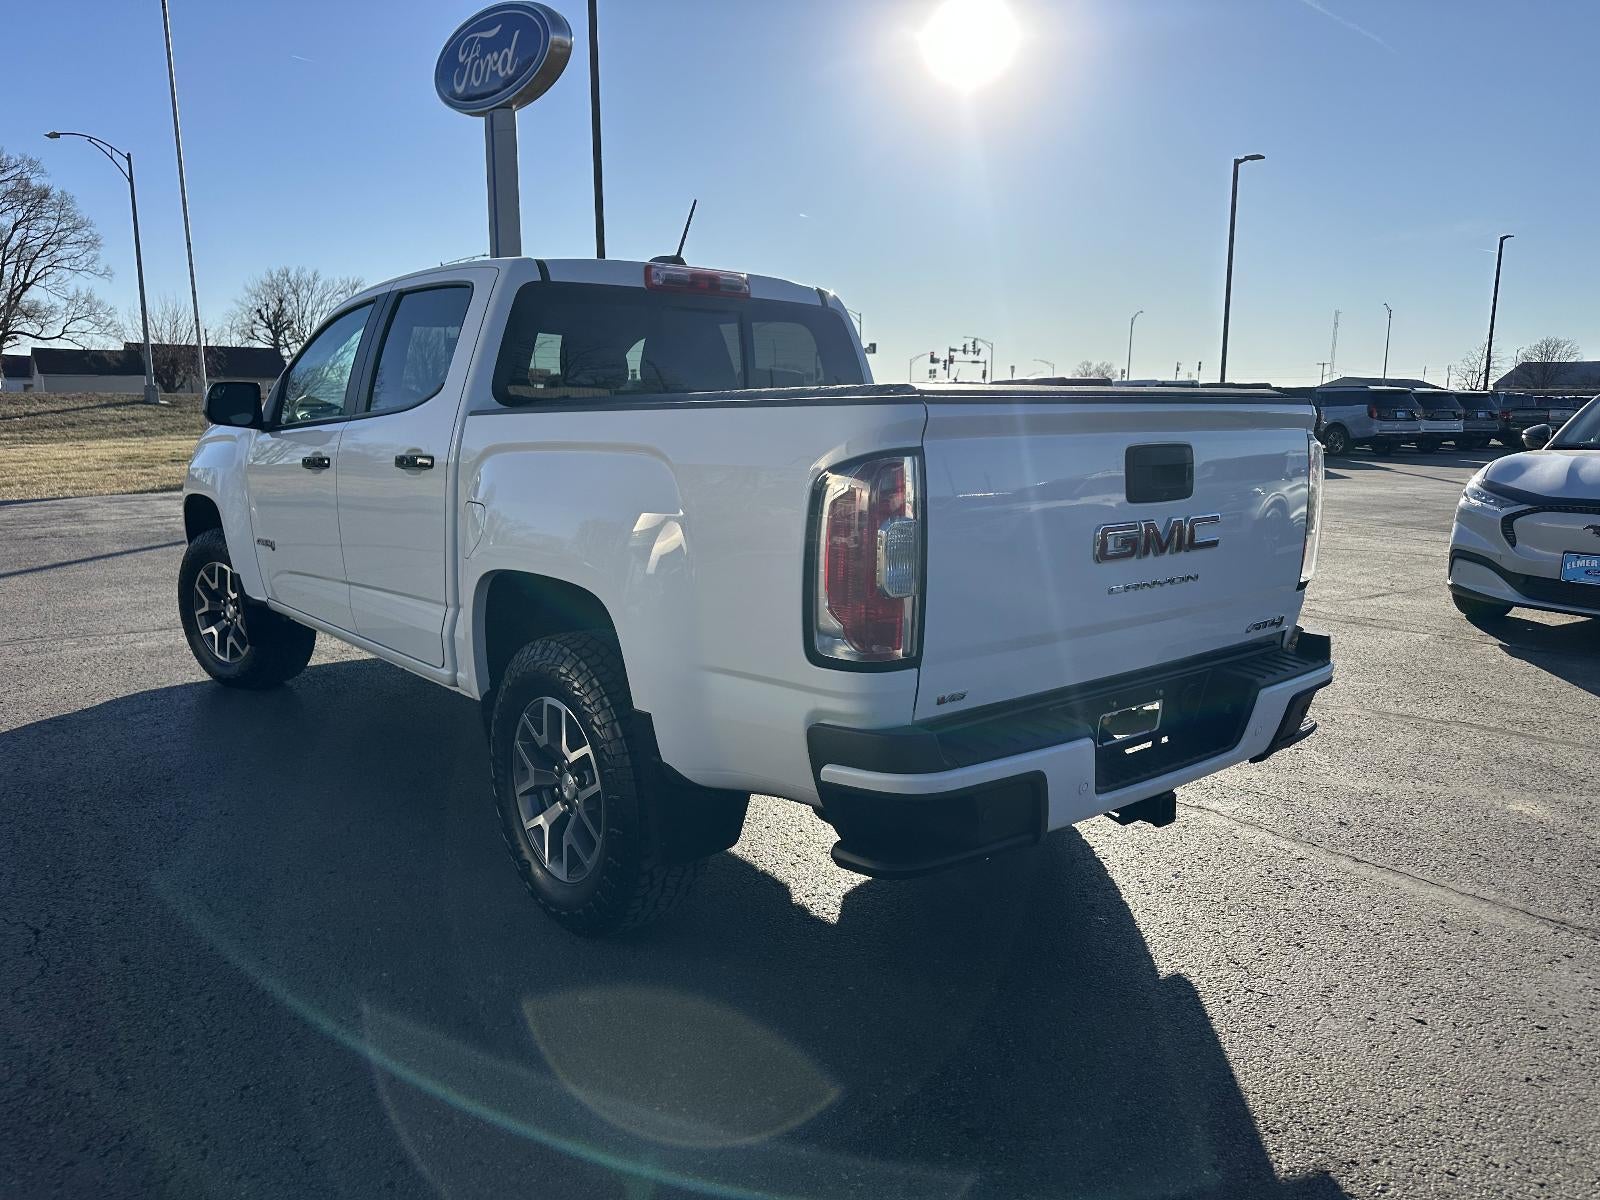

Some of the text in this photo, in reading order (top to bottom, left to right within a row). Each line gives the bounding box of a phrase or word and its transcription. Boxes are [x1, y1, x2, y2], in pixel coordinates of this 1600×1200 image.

[453, 23, 520, 94] Ford
[1093, 513, 1221, 564] GMC
[1566, 559, 1598, 570] ELMER
[1107, 572, 1200, 596] CANYON
